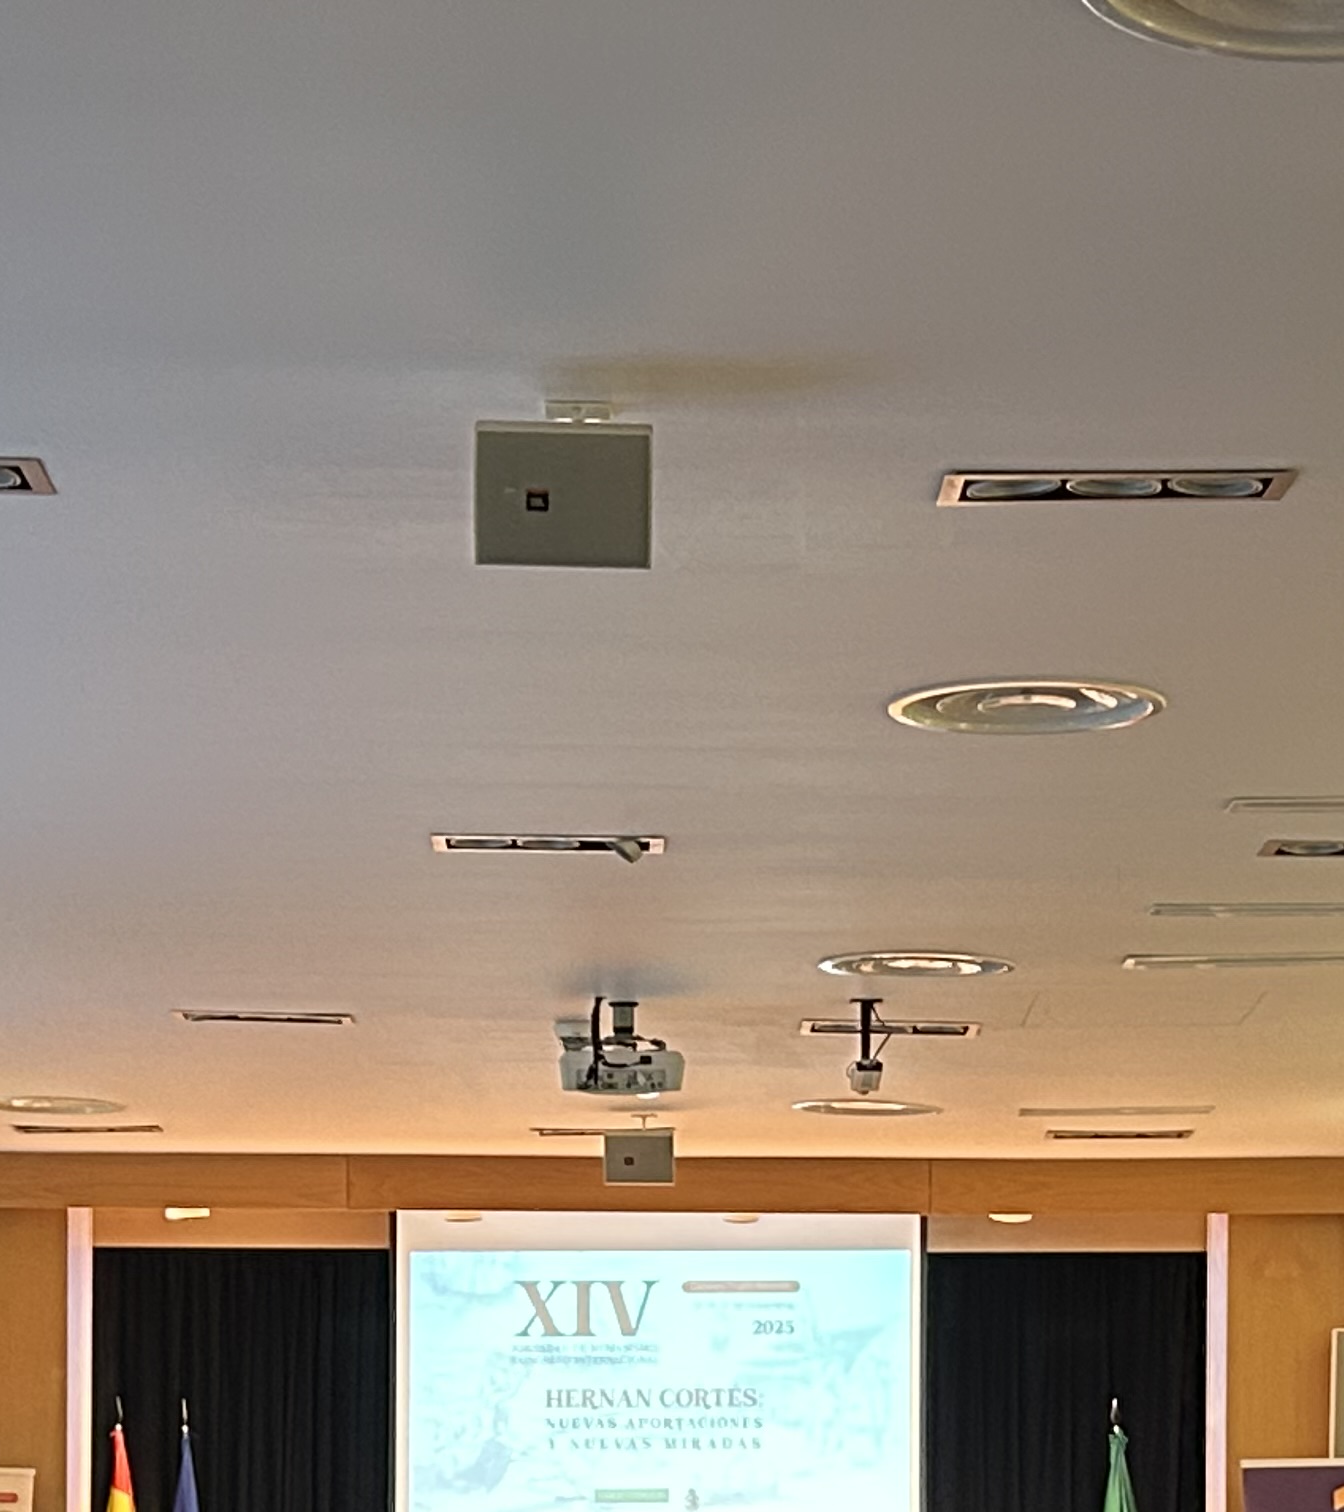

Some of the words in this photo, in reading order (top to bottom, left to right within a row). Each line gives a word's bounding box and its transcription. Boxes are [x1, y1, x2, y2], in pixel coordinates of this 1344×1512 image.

[513, 1280, 660, 1337] XIV
[752, 1319, 795, 1335] 2025
[545, 1417, 618, 1430] NUEVAS
[625, 1417, 764, 1431] APORTACIONES
[664, 1437, 762, 1451] MIRADAS
